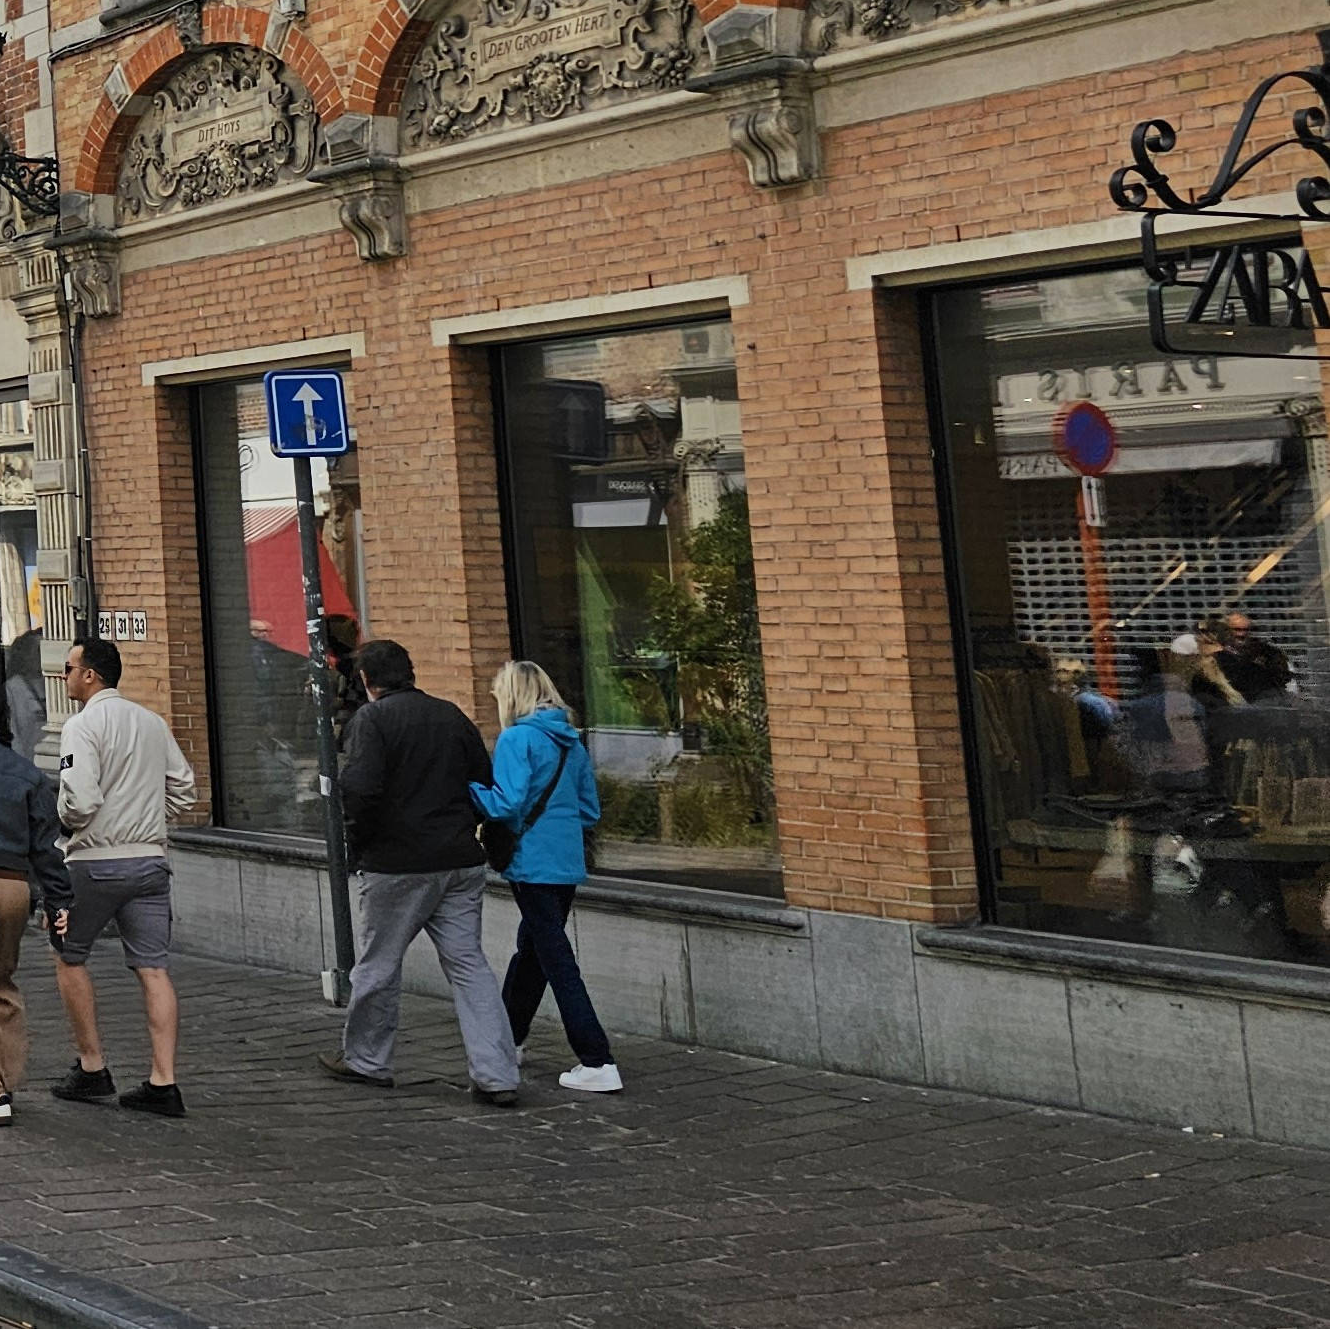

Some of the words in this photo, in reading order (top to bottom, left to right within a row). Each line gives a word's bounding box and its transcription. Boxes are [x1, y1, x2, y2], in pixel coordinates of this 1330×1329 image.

[488, 40, 512, 59] DEN
[515, 22, 571, 51] GROOTEN
[575, 13, 607, 35] HERT
[198, 127, 215, 143] DIT
[99, 617, 111, 635] 29
[117, 617, 128, 635] 31
[134, 617, 145, 635] 33
